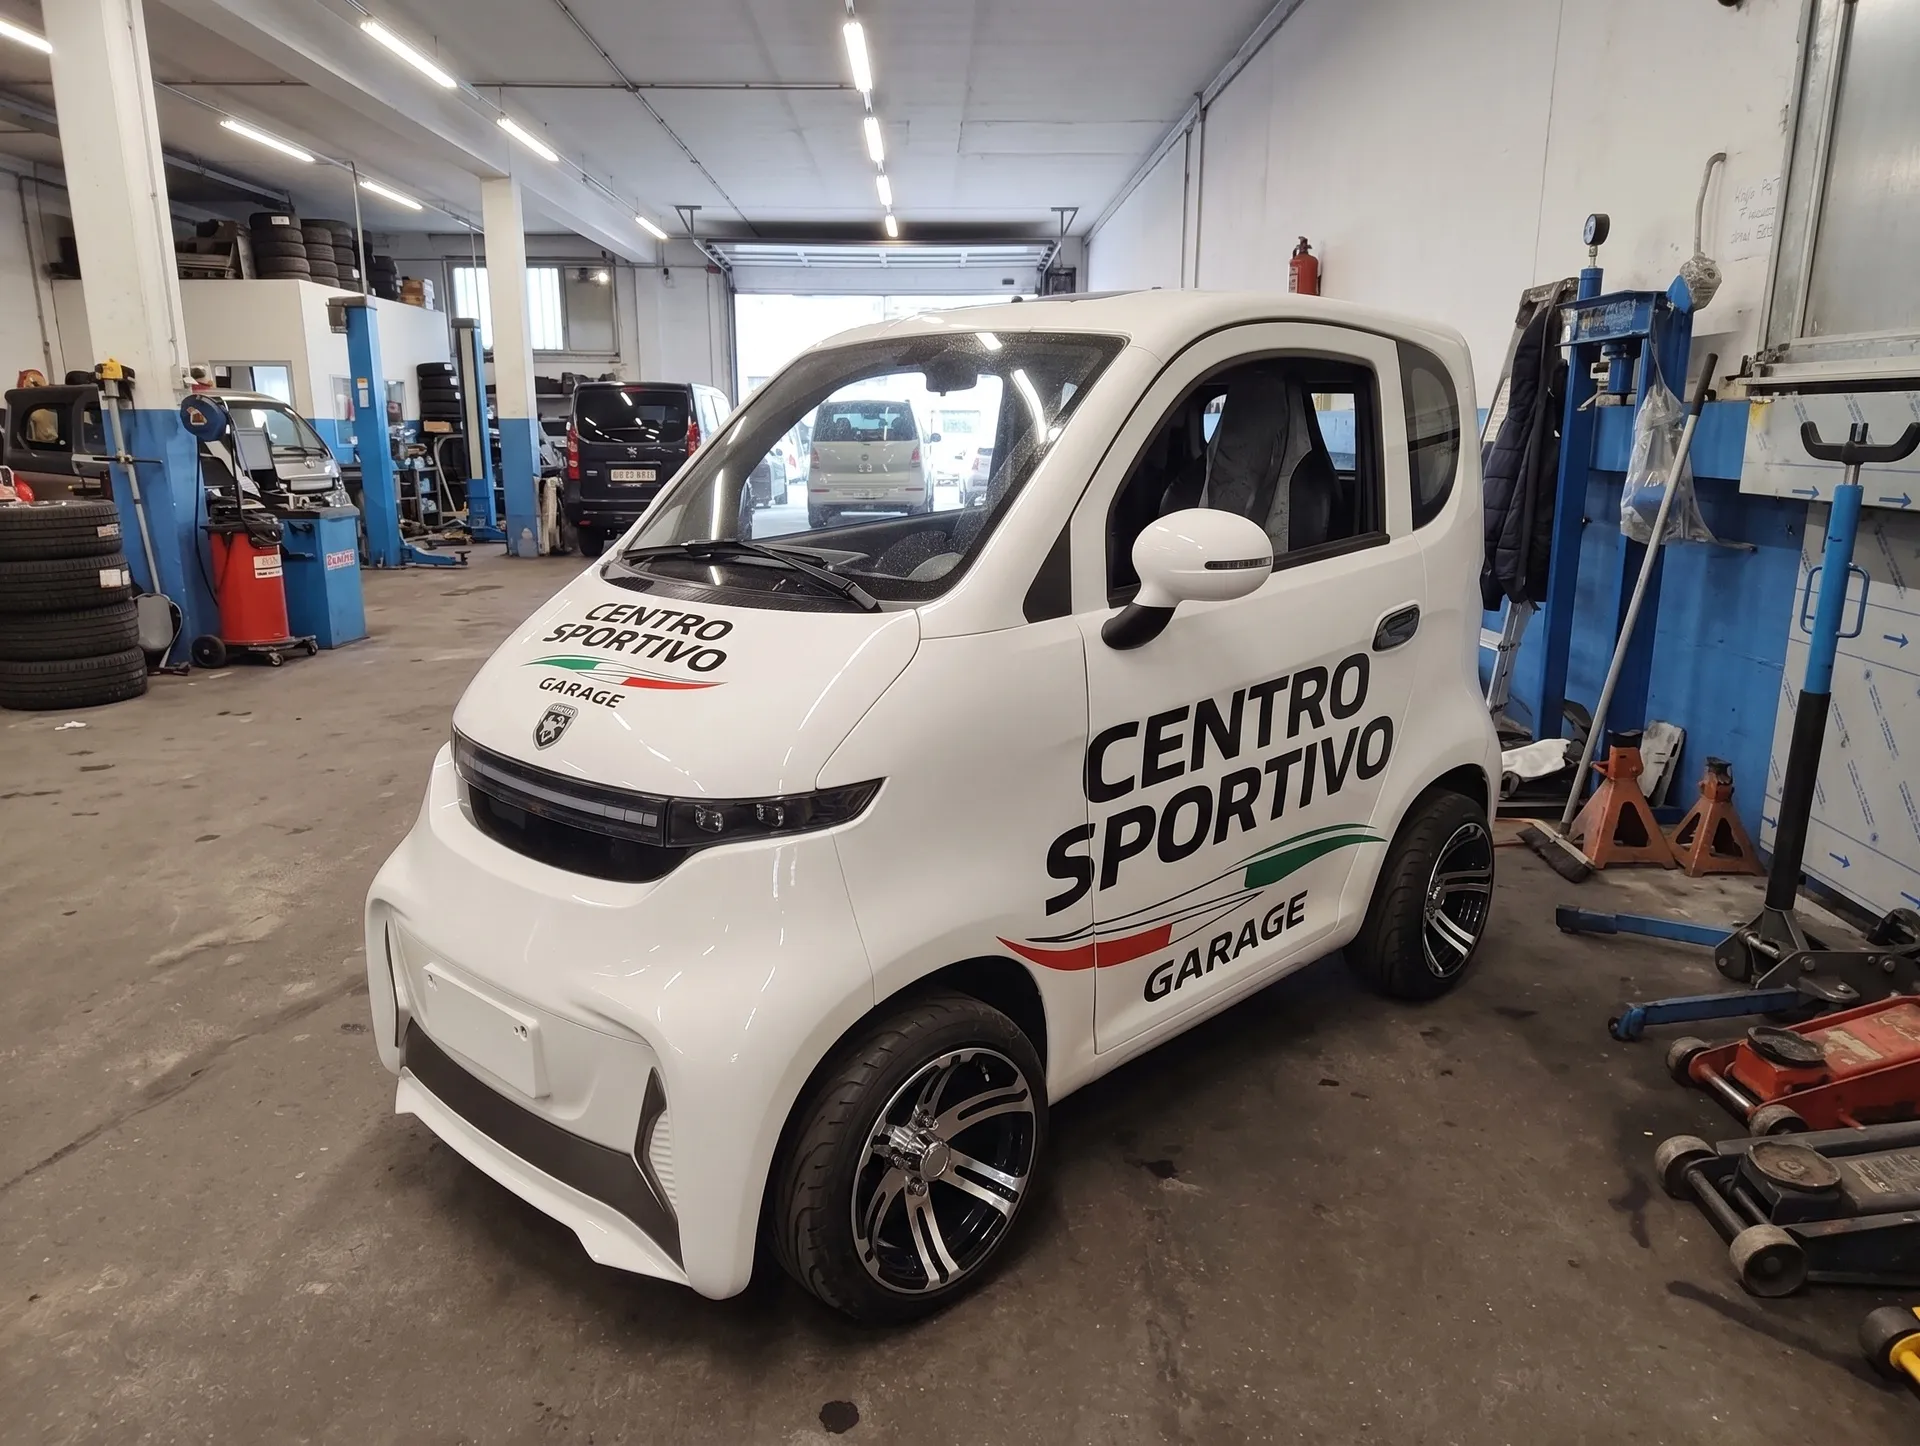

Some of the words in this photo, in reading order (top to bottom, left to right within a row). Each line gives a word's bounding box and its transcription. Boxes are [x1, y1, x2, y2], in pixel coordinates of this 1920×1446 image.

[542, 623, 727, 672] SPORTIVO
[585, 603, 733, 641] CENTRO
[539, 677, 625, 708] GARAGE
[1083, 653, 1370, 803] CENTRO
[1045, 715, 1394, 917] SPORTIVO
[1144, 889, 1309, 1003] GARAGE
